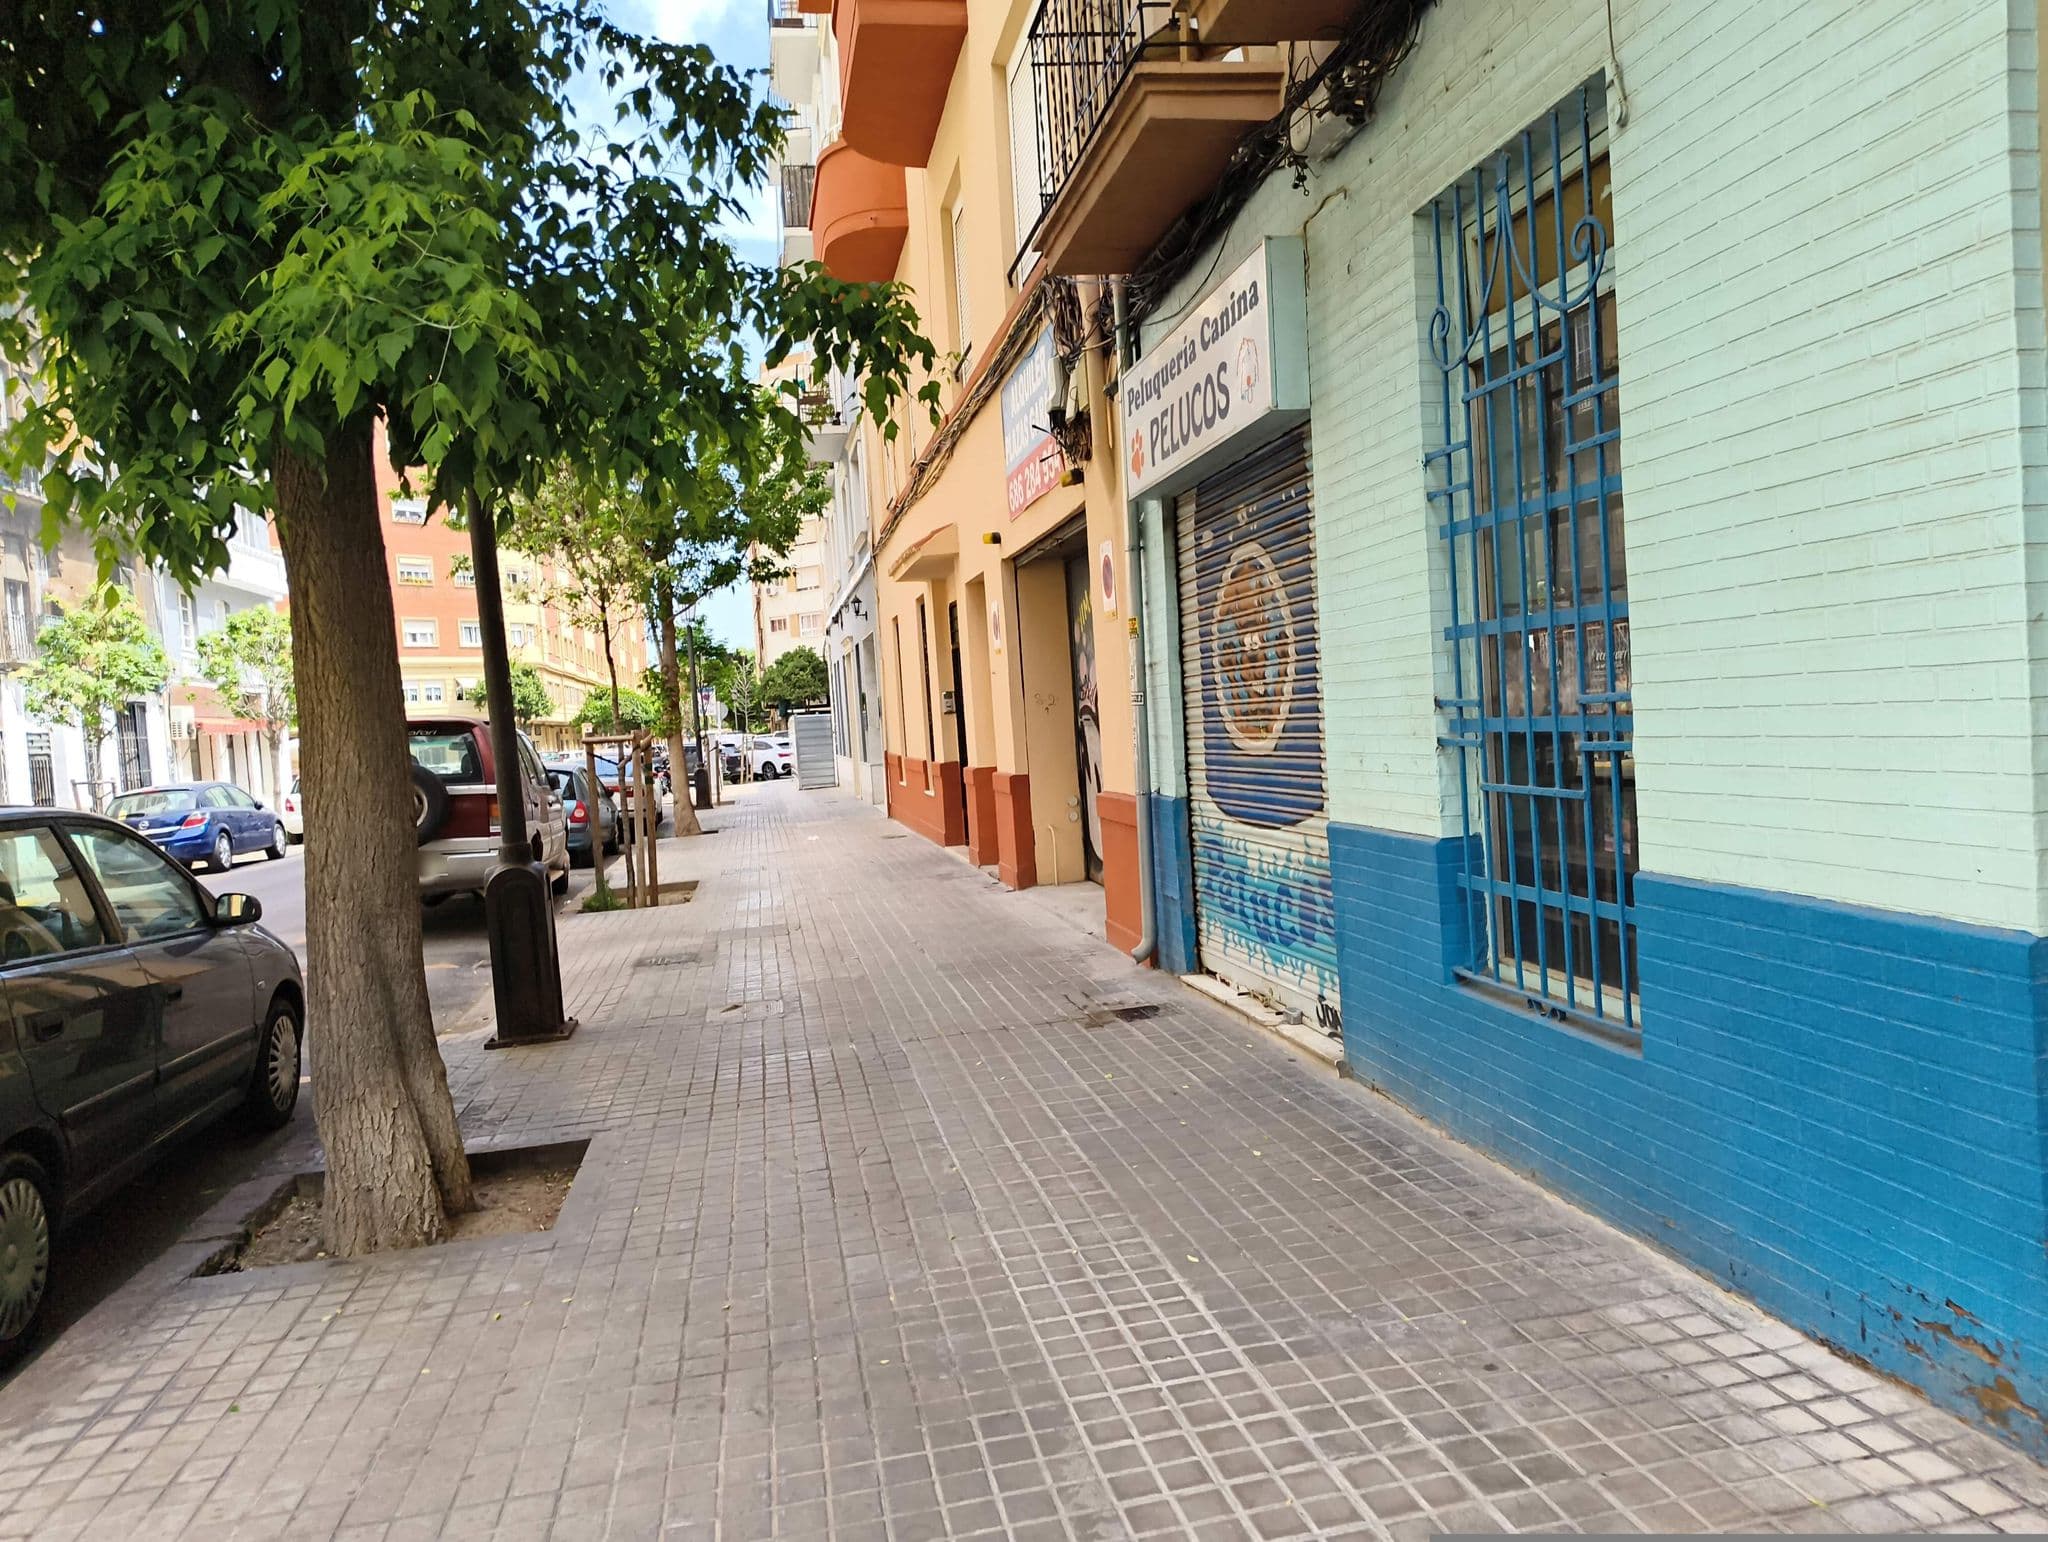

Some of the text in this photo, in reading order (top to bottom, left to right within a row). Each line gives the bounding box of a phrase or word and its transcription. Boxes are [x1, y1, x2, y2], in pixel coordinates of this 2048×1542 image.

[1011, 345, 1048, 418] ALQUILER
[1127, 280, 1260, 418] Peluquería Canina
[1149, 361, 1230, 468] PELUCOS
[1009, 473, 1024, 512] 686
[1025, 455, 1041, 500] 284
[408, 728, 438, 736] afari
